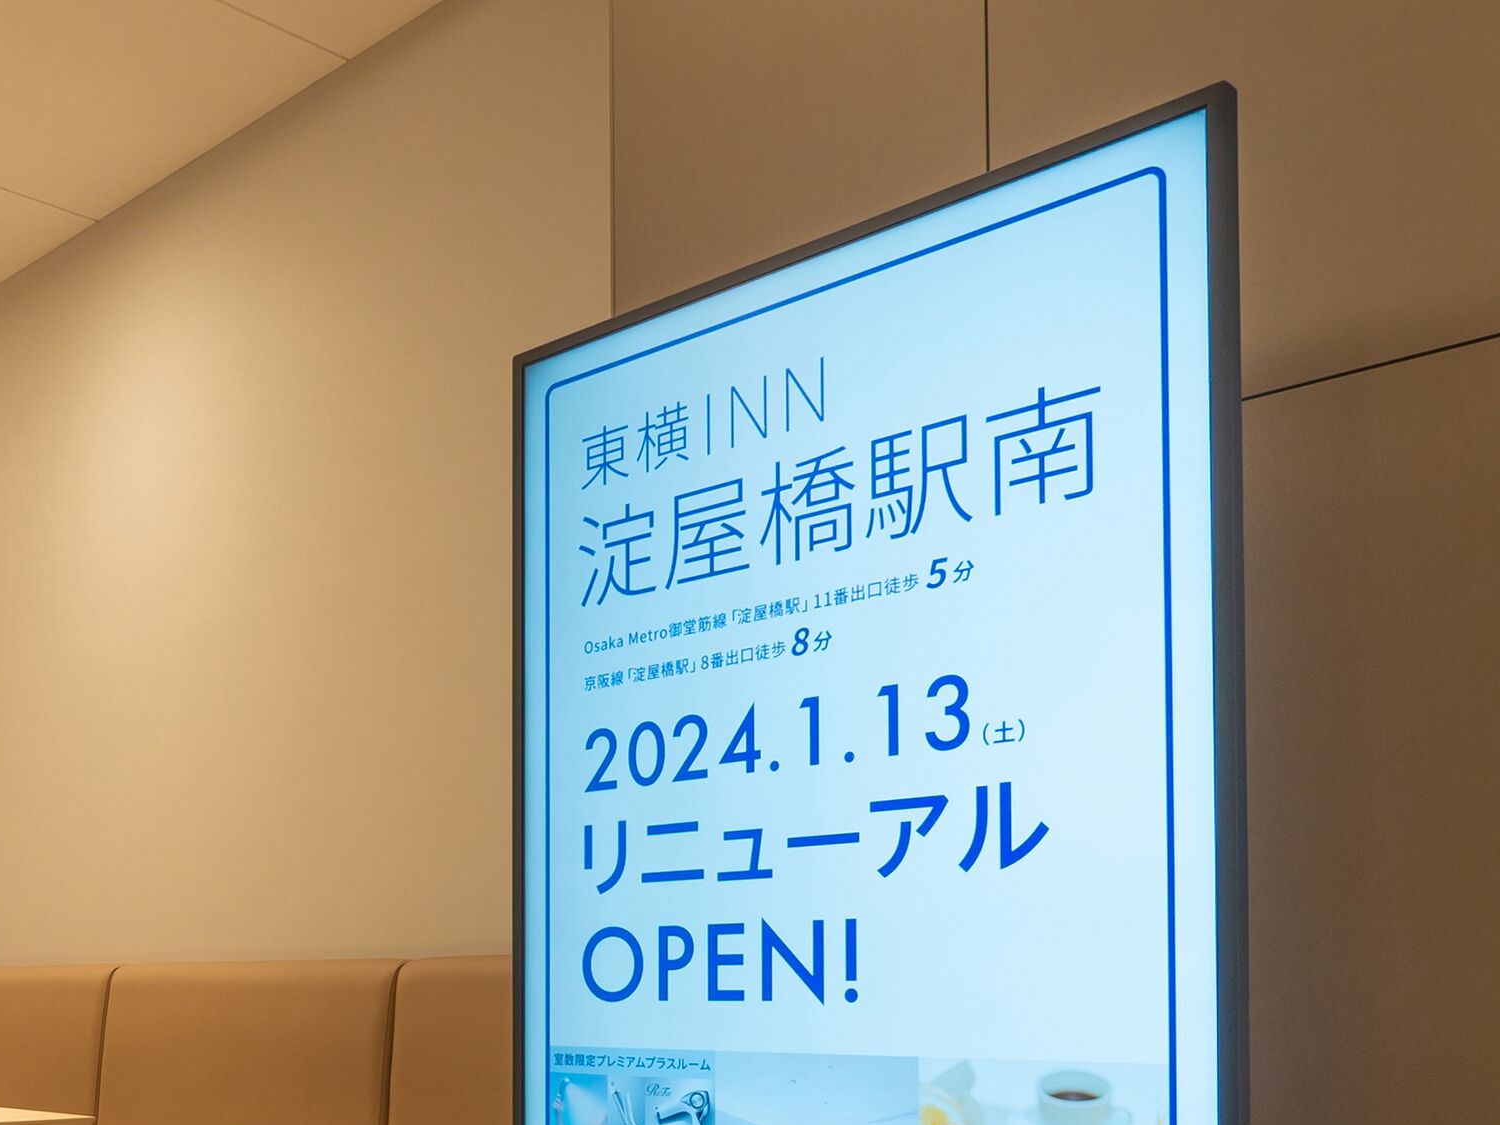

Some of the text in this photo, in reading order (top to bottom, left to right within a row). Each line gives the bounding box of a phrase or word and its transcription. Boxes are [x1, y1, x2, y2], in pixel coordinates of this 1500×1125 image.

[581, 357, 825, 491] 東横INN
[578, 386, 1101, 608] 淀屋橋駅南
[583, 635, 625, 655] Osaka
[583, 781, 1050, 895] リニューアル
[582, 917, 859, 1006] OPEN!
